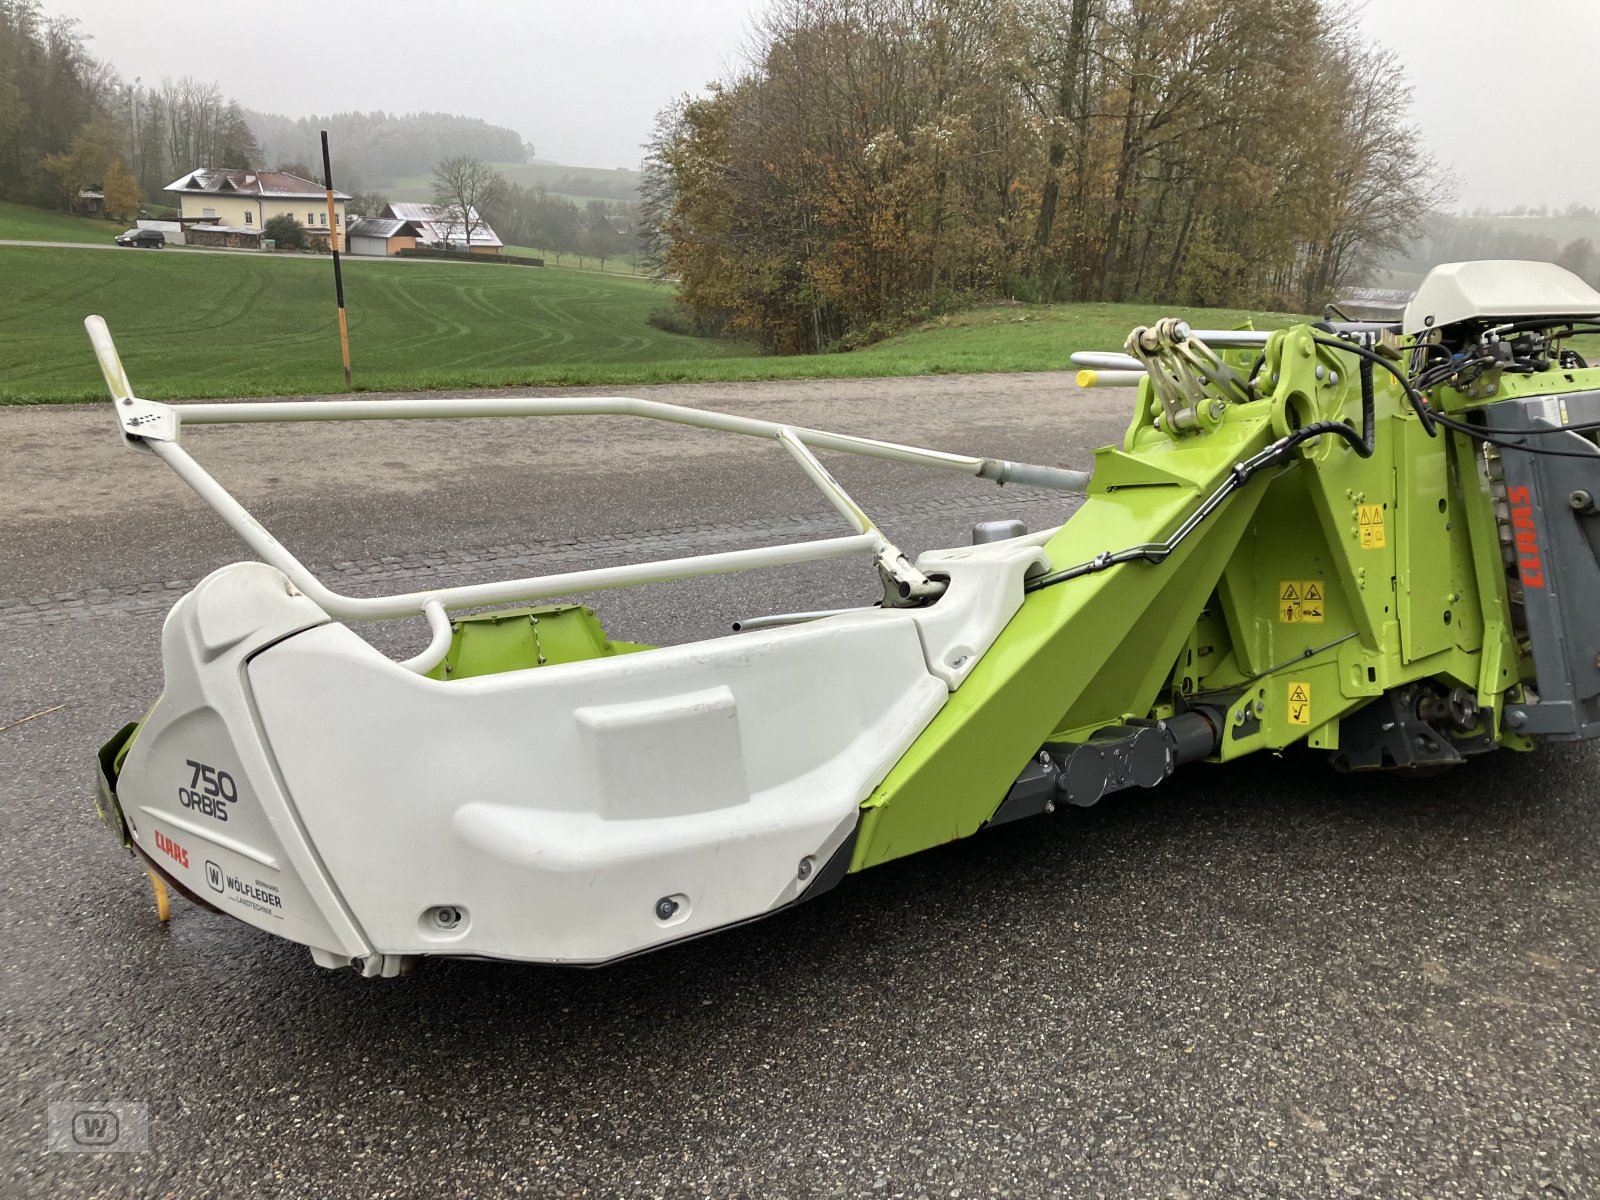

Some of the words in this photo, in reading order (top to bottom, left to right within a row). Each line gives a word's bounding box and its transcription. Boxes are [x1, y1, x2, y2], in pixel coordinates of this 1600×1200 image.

[1507, 485, 1544, 588] CLAAS
[186, 759, 238, 803] 750
[178, 787, 228, 822] ORBIS
[154, 830, 189, 869] CLAAS
[209, 868, 219, 886] W
[226, 875, 282, 908] WÖLFLEDER
[236, 897, 273, 915] LANDTECHNIK
